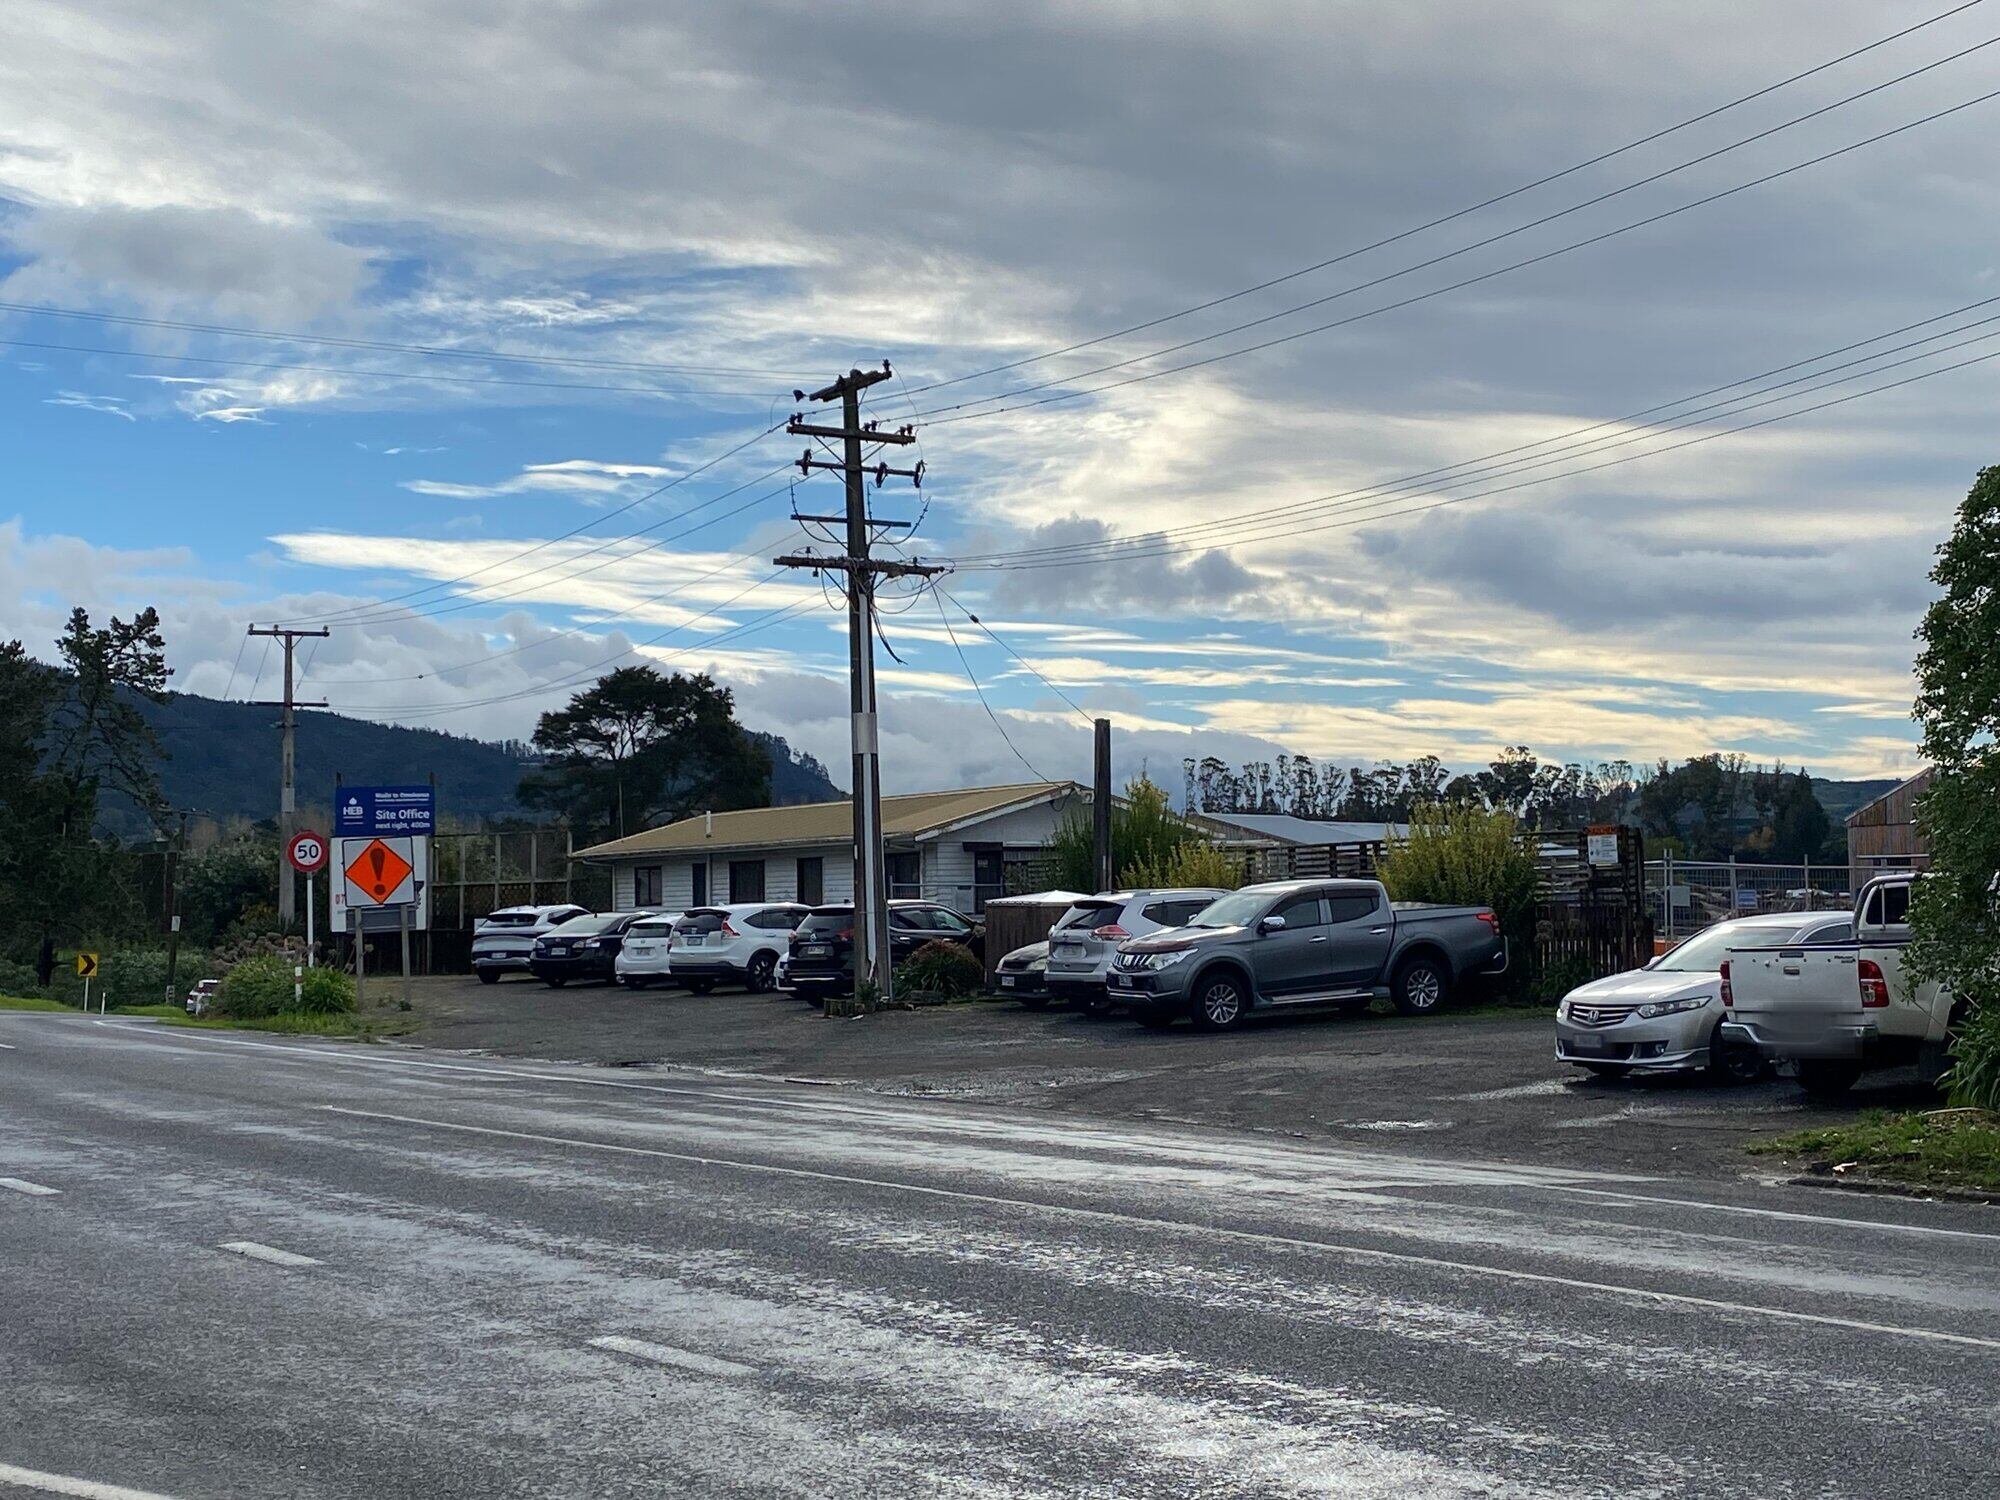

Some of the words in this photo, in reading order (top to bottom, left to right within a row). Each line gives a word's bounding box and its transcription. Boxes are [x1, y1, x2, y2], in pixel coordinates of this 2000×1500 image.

[342, 806, 363, 815] HEB
[375, 809, 396, 820] Site
[398, 808, 430, 819] Office
[298, 844, 319, 859] 50
